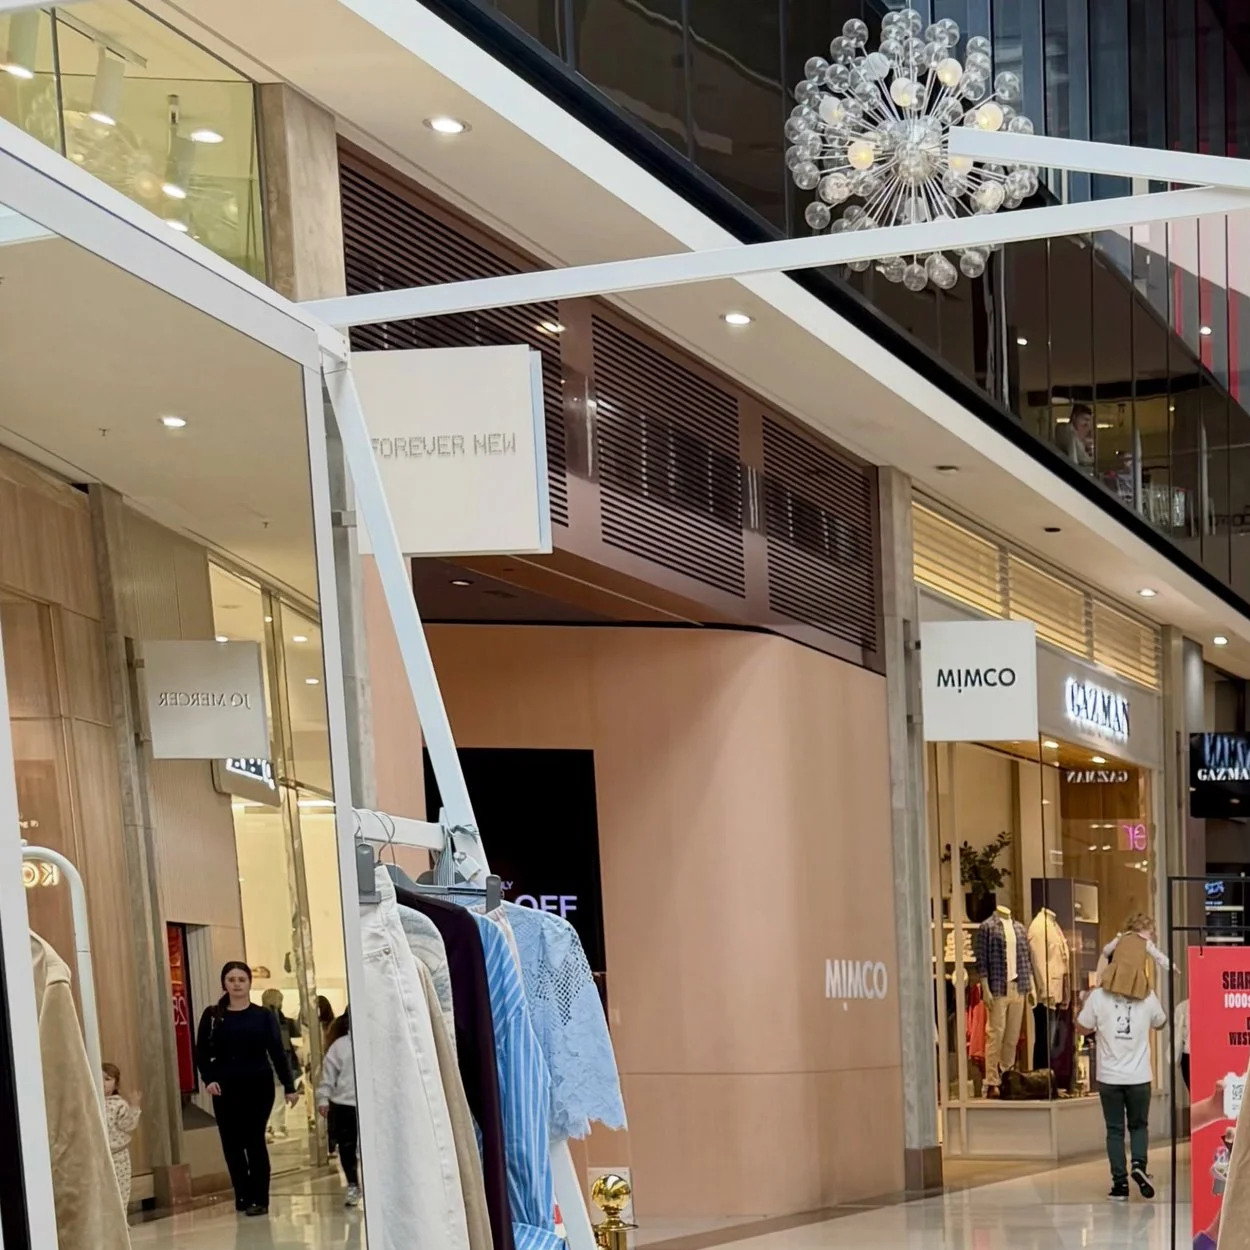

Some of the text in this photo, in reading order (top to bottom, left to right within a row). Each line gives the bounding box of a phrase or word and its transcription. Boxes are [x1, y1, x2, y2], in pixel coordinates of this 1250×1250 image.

[474, 432, 516, 455] NEW
[936, 667, 1016, 693] MIMCO
[1070, 680, 1131, 738] GAZMAN
[825, 959, 888, 1011] MIMCO
